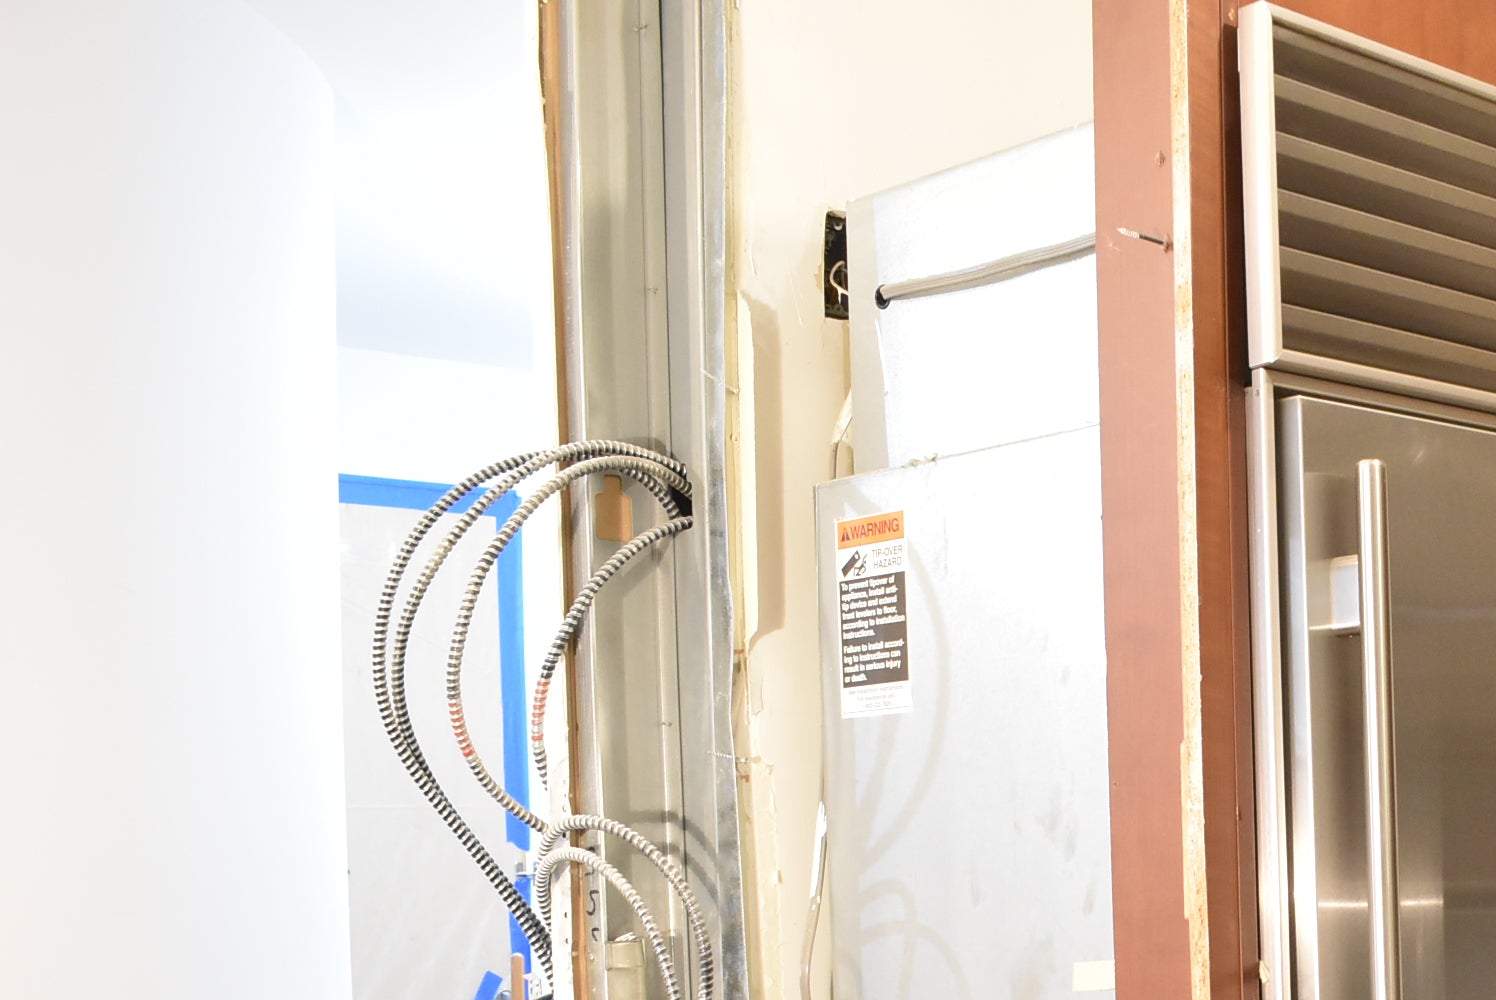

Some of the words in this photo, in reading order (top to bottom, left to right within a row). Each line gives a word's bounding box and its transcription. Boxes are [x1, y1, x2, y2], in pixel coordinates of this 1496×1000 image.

[850, 518, 899, 540] WARNING
[872, 545, 903, 558] TIP-OVER
[873, 557, 902, 569] HAZARD
[841, 583, 848, 591] To
[849, 580, 868, 592] prevent
[889, 575, 895, 583] of
[868, 587, 885, 597] install
[850, 600, 867, 610] device
[868, 598, 878, 607] and
[879, 595, 897, 605] extend
[842, 612, 855, 620] front
[877, 607, 882, 615] to
[842, 619, 868, 630] according
[869, 618, 875, 626] to
[876, 614, 905, 625] installation
[843, 643, 861, 654] Failure
[862, 643, 868, 651] to
[868, 640, 884, 650] install
[859, 650, 890, 661] instructions
[891, 649, 901, 658] can
[844, 663, 859, 673] result
[866, 660, 885, 671] serious
[886, 659, 901, 670] injury
